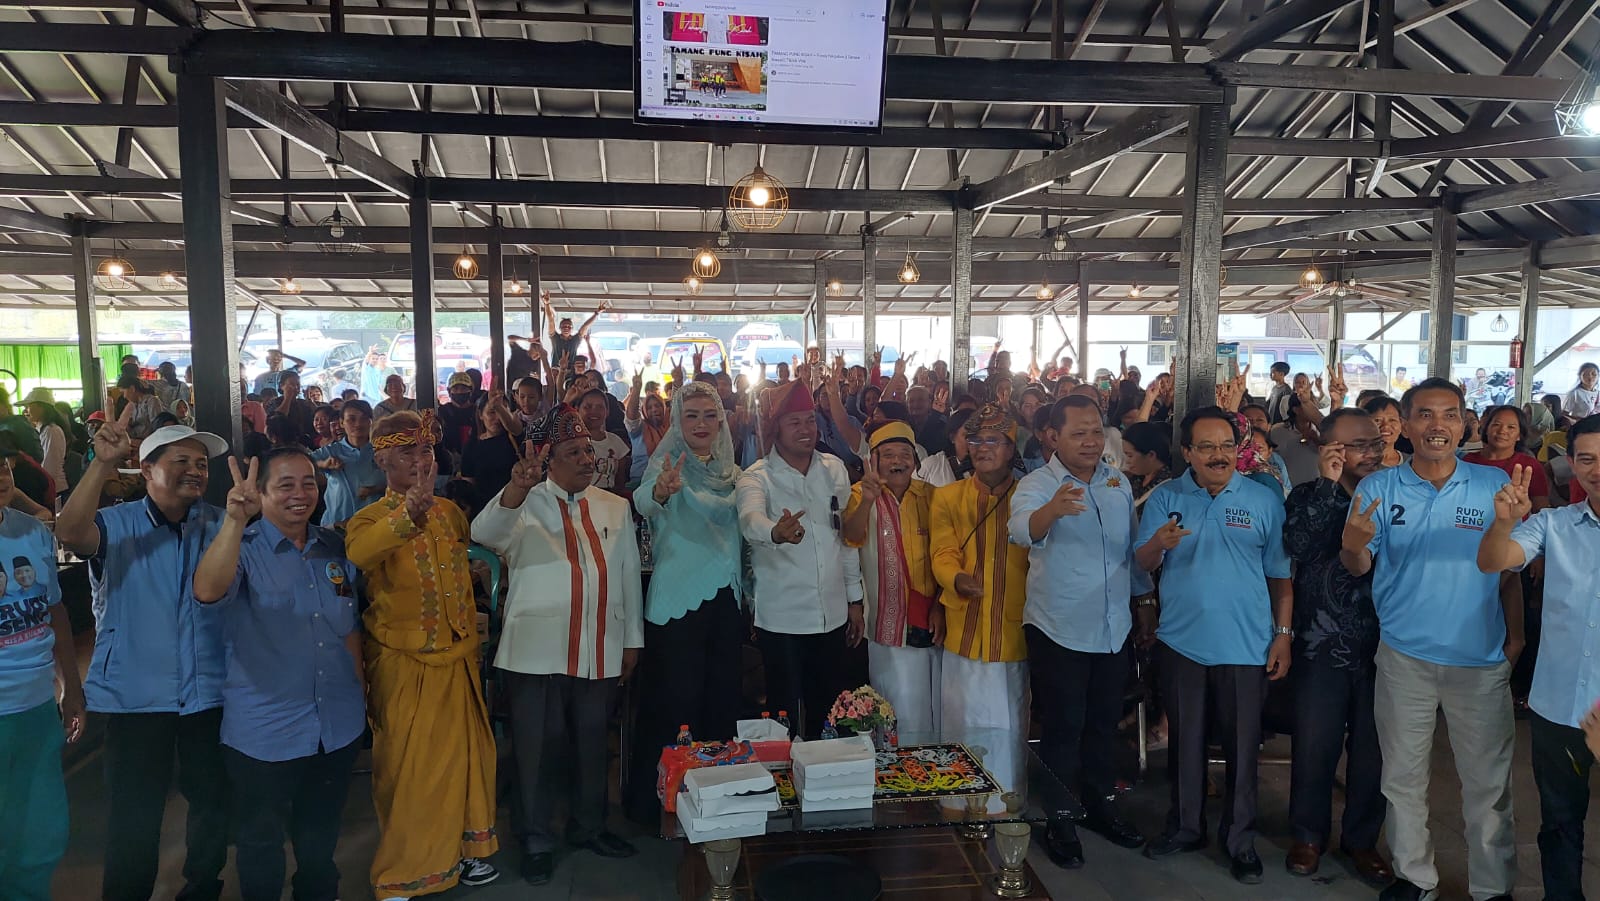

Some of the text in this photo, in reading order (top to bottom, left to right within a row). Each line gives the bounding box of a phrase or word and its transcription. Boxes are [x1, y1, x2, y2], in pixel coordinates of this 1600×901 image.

[671, 46, 704, 55] TAMANG
[1225, 507, 1250, 517] RUDY
[1390, 504, 1406, 526] 2
[1456, 506, 1485, 517] RUDY
[1225, 515, 1251, 525] SENO
[1455, 515, 1484, 526] SENO
